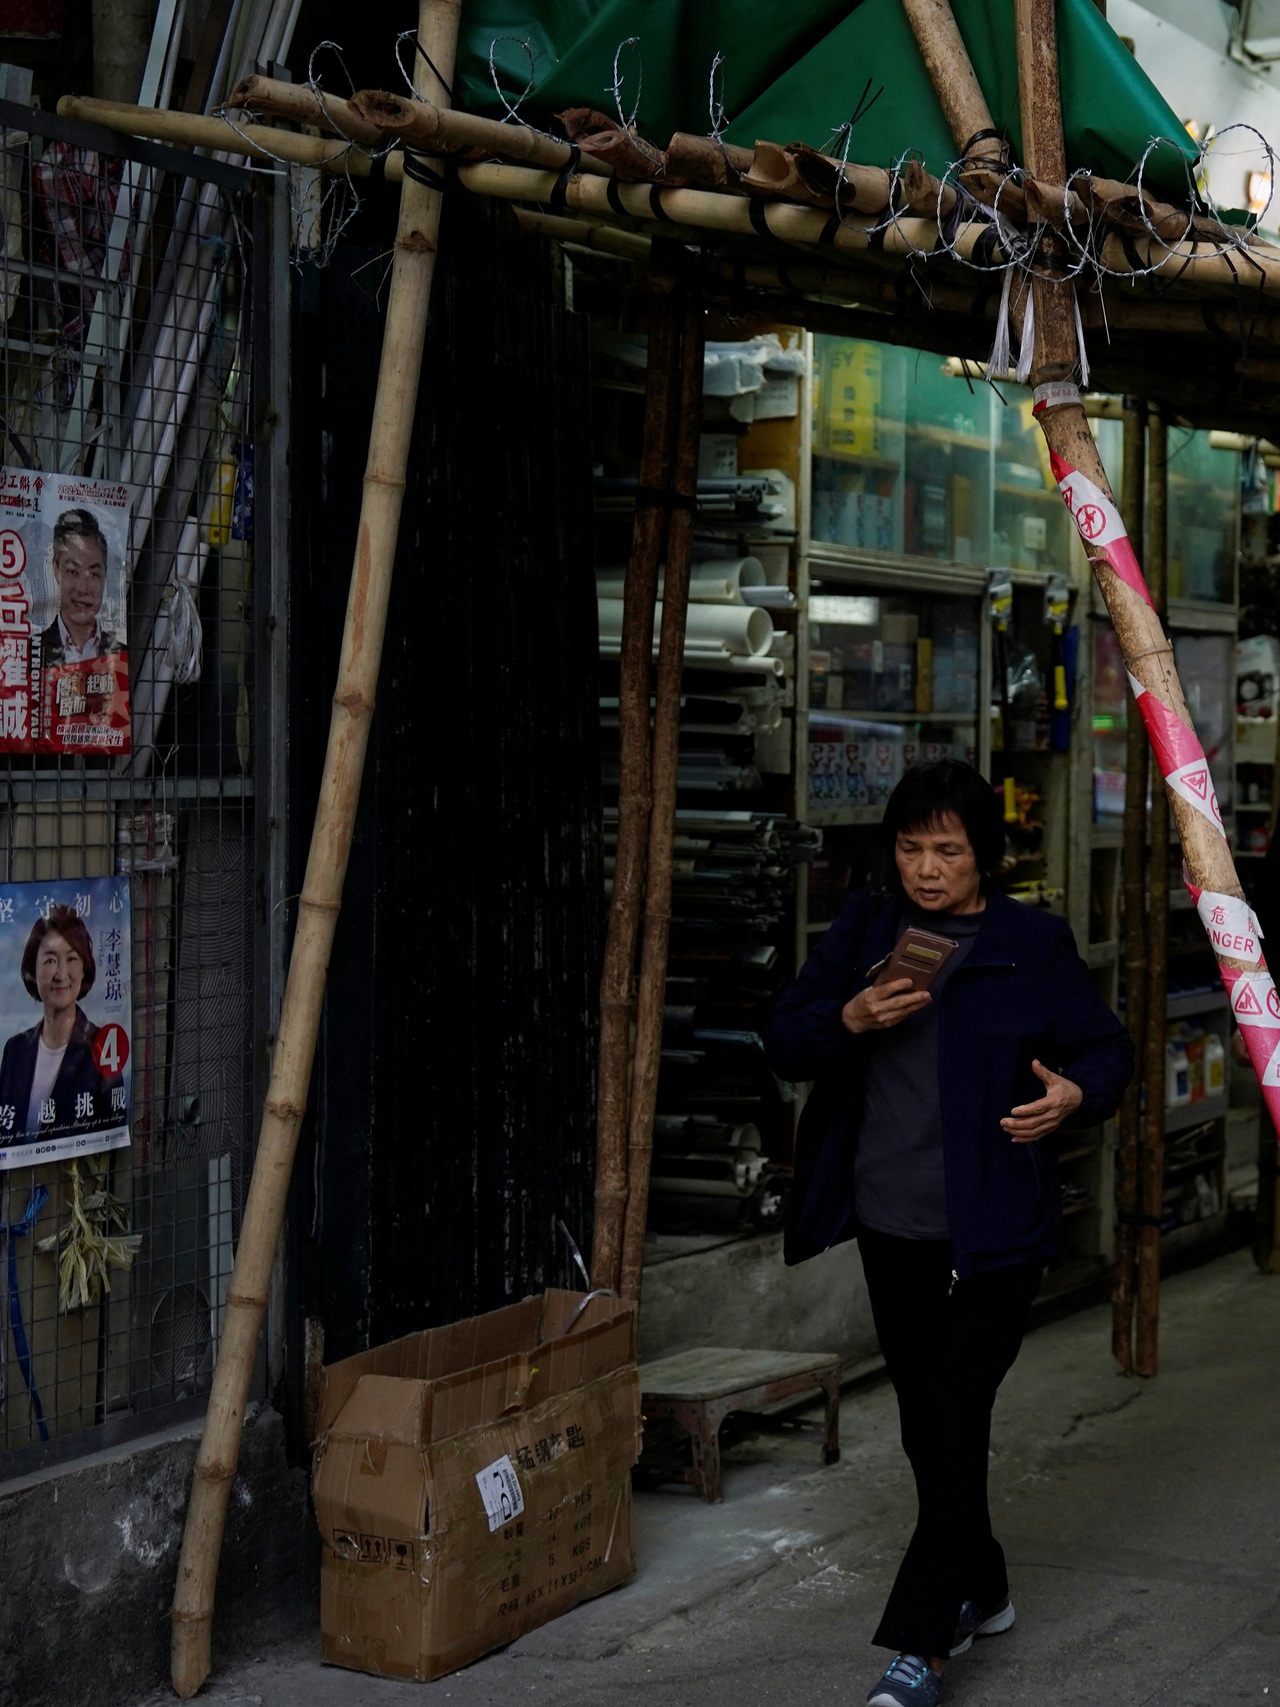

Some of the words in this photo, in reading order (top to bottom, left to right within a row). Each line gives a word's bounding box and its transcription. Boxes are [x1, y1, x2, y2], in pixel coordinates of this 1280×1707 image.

[2, 540, 16, 570] 5
[31, 701, 41, 739] YAU
[1206, 927, 1255, 954] NGER
[100, 1027, 120, 1072] 4
[572, 1537, 591, 1558] KGS
